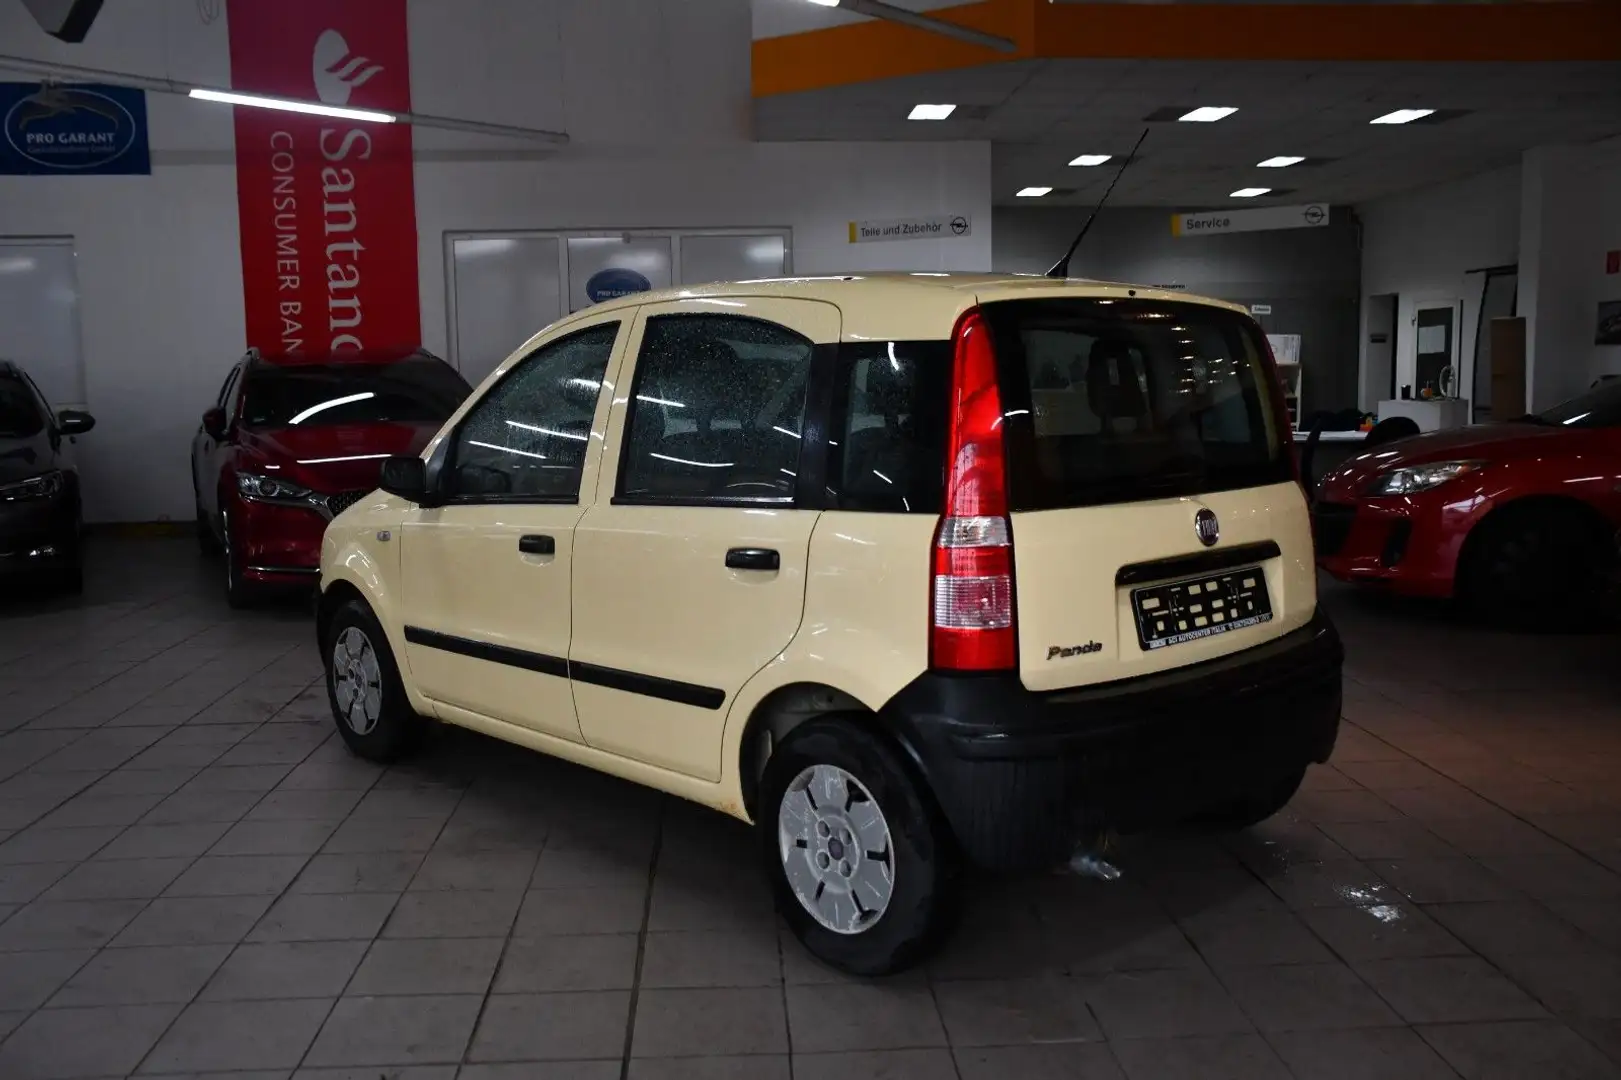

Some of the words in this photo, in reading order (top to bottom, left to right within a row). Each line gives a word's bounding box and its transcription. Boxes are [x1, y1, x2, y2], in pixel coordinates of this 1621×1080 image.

[26, 132, 54, 144] PRO
[58, 132, 116, 144] GARANT
[270, 130, 300, 291] CONSUMER
[861, 226, 881, 238] Teile
[883, 224, 900, 236] und
[902, 221, 942, 234] Zubehör
[1186, 216, 1231, 231] Service
[1178, 628, 1210, 642] AUTOCENTER
[1046, 640, 1102, 660] Panda
